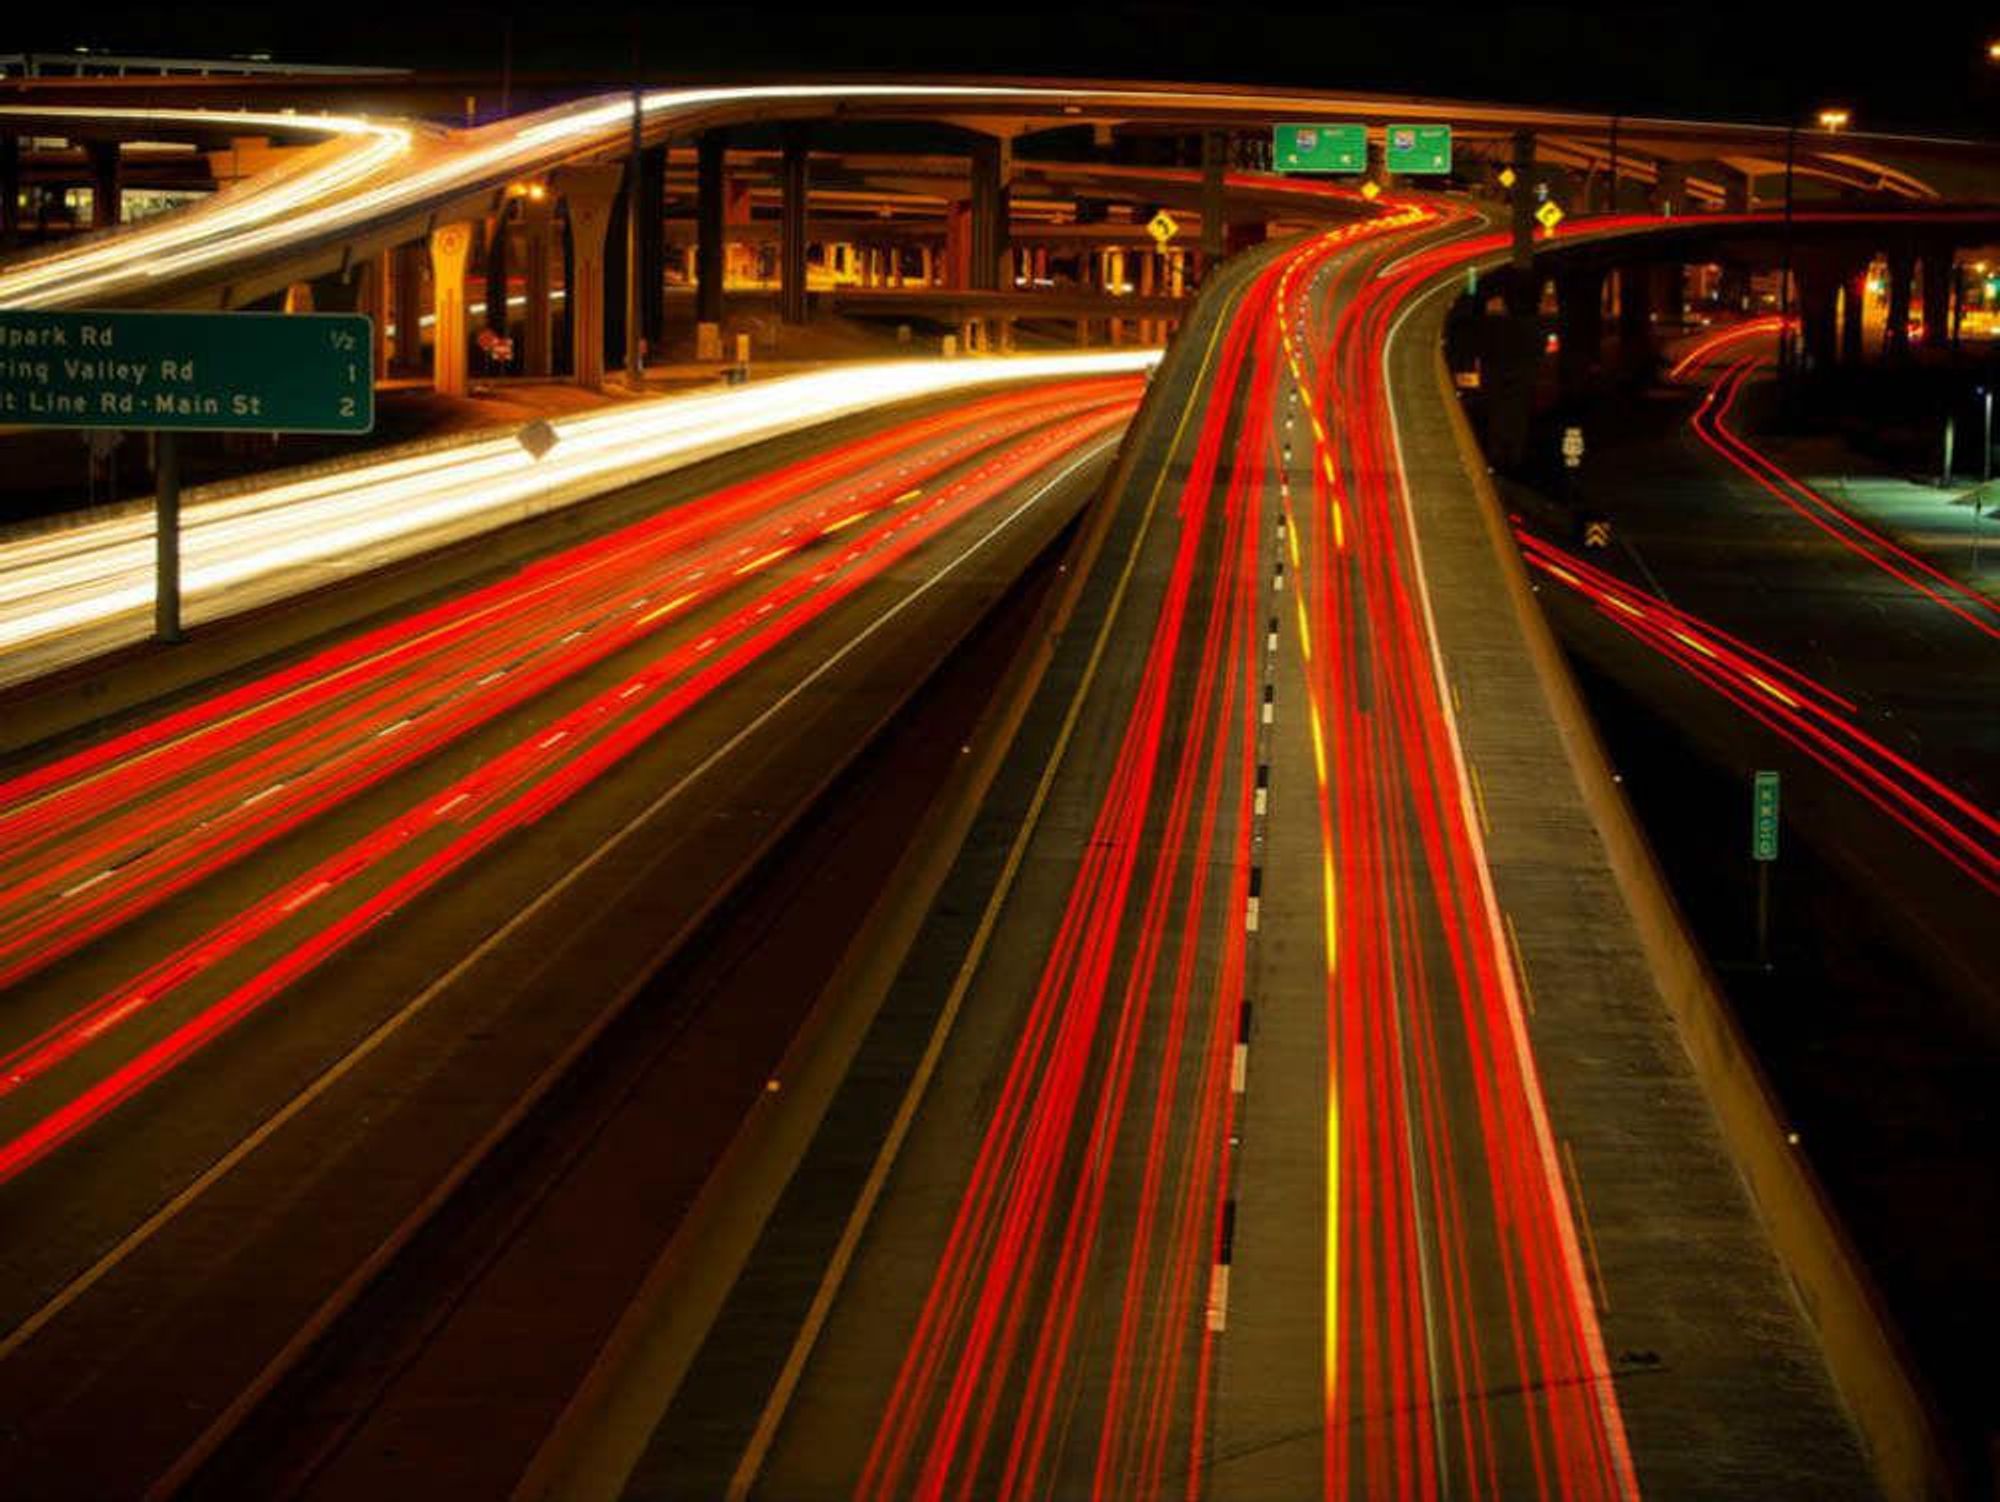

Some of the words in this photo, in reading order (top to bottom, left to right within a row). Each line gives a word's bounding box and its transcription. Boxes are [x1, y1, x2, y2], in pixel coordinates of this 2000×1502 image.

[81, 325, 113, 346] Rd
[64, 359, 147, 385] Valley
[161, 359, 194, 381] Rd
[29, 391, 86, 414] Line
[155, 393, 218, 415] Main
[232, 394, 260, 416] St
[340, 397, 355, 417] 2
